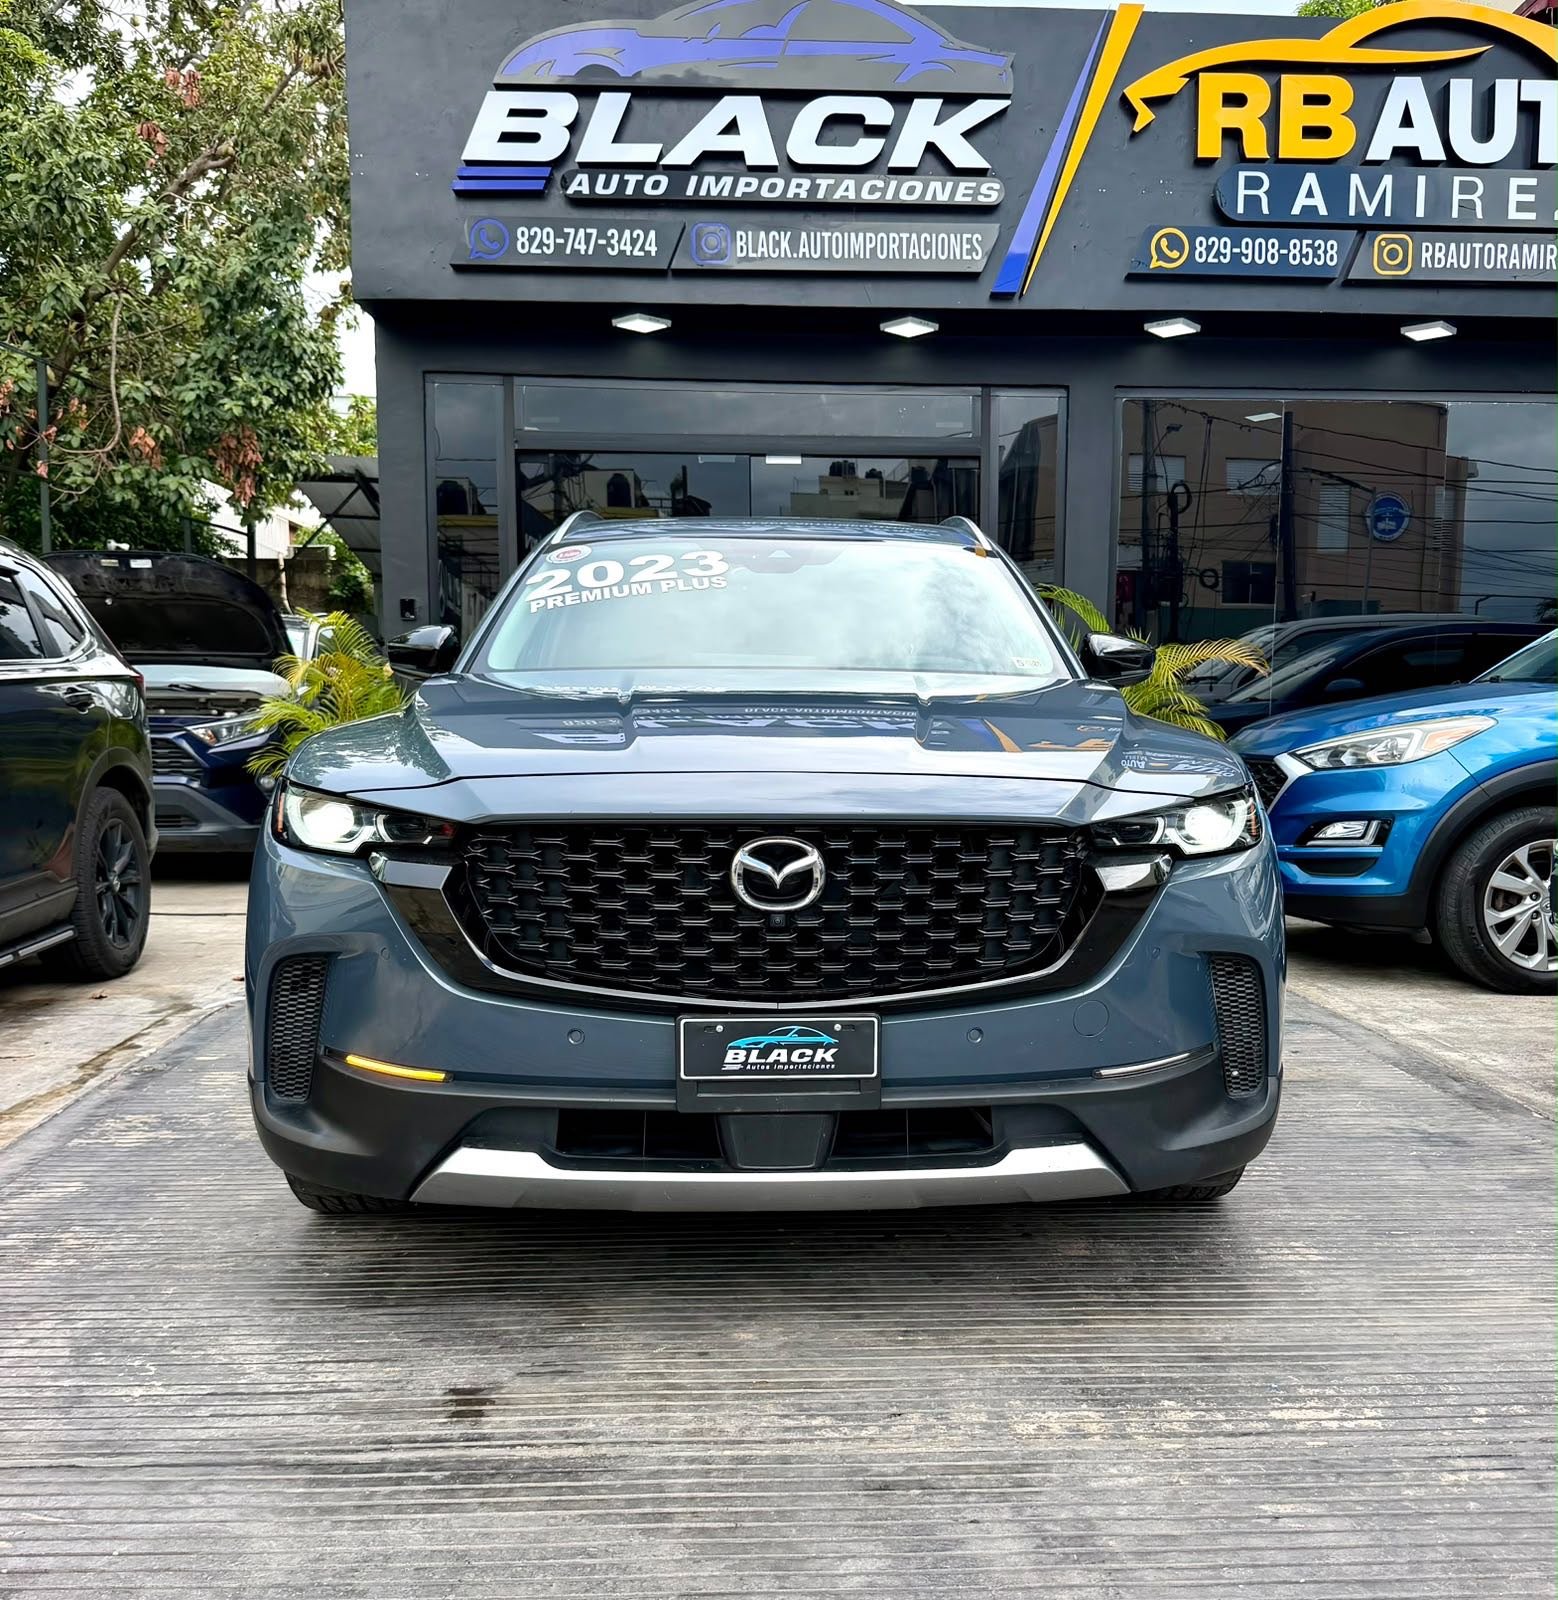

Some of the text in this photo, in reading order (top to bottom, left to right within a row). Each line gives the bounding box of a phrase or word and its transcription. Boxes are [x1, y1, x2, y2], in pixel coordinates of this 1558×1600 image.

[460, 90, 1012, 170] BLACK
[565, 173, 1002, 203] AUTO IMPORTACIONES
[1236, 170, 1558, 221] RAMIRE
[516, 228, 658, 257] 829-747-3424
[736, 230, 983, 261] BLACK.AUTOIMPORTACIONES
[1194, 236, 1338, 267] 829-908-8538
[1421, 242, 1558, 270] RBAUTORAMIR
[525, 550, 729, 602] 2023
[530, 576, 728, 613] PREMIUM PLUS
[723, 1048, 839, 1063] BLACK
